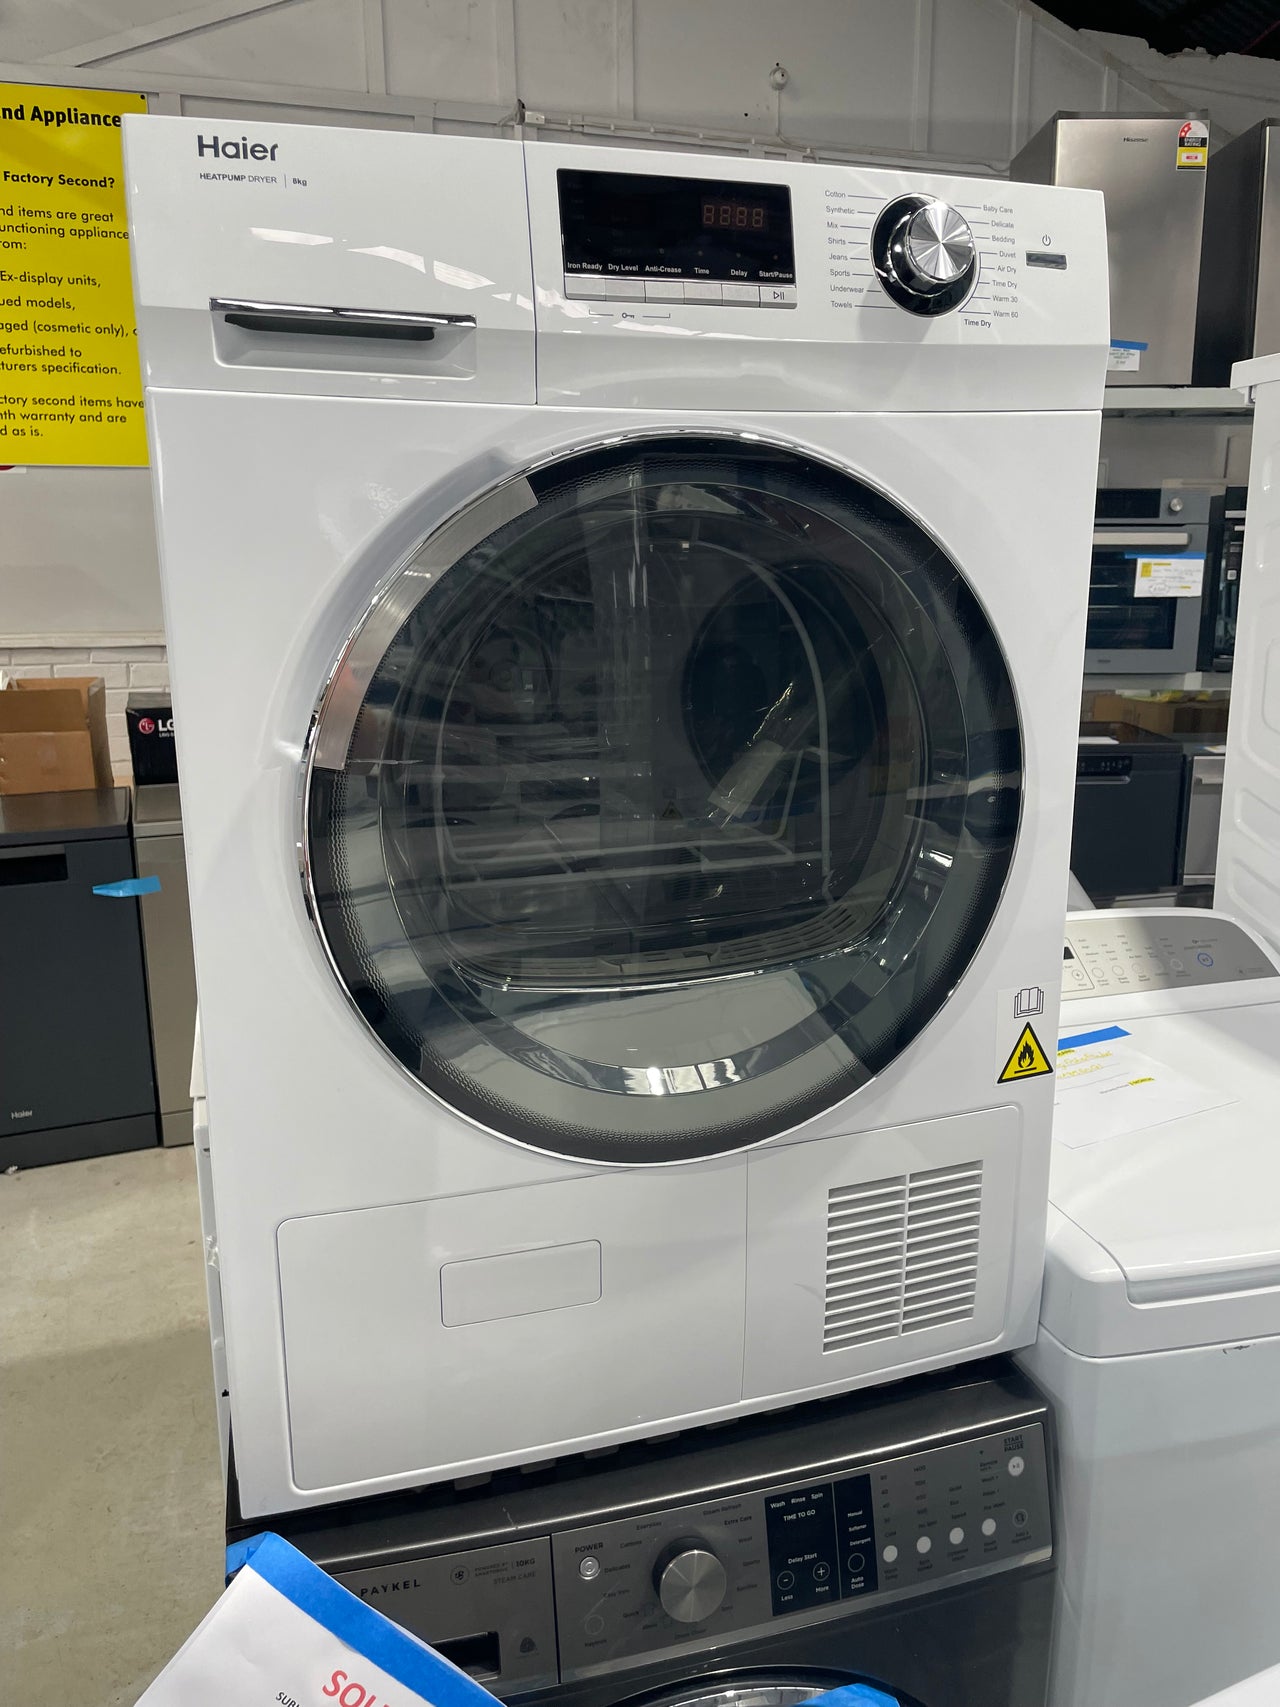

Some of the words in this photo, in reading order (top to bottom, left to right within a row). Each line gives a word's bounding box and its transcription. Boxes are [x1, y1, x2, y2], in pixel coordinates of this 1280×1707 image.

[197, 134, 279, 161] Haier
[3, 171, 53, 187] Factory
[58, 174, 115, 188] Second?
[199, 172, 246, 182] HEATPUMP
[248, 175, 277, 184] DRYER
[292, 177, 307, 187] 8kg
[824, 190, 846, 199] Cotton
[826, 205, 855, 216] Synthetic
[983, 204, 997, 214] Baby
[998, 206, 1013, 214] Care
[18, 206, 52, 218] items
[56, 211, 77, 220] are
[81, 212, 114, 223] great
[826, 221, 838, 230] Mix
[991, 220, 1014, 229] Delicate
[827, 237, 846, 246] Shirts
[991, 235, 1016, 245] Bedding
[829, 253, 848, 261] Jeans
[999, 250, 1016, 259] Duvet
[567, 262, 581, 270] Iron
[582, 263, 603, 272] Ready
[608, 263, 619, 272] Dry
[644, 265, 682, 274] Anti-Crease
[694, 267, 710, 275] Time
[1005, 266, 1017, 274] Dry
[730, 269, 748, 277] Delay
[758, 270, 793, 279] Start/Pause
[829, 269, 850, 278] Sports
[1, 271, 63, 287] Ex-display
[68, 275, 101, 288] units,
[830, 286, 864, 294] Underwear
[992, 280, 1005, 288] Time
[1006, 281, 1017, 290] Dry
[26, 297, 75, 310] models,
[831, 301, 853, 309] Towels
[1010, 311, 1018, 319] 60
[0, 320, 28, 333] aged
[33, 320, 91, 334] (cosmetic
[95, 323, 129, 338] only),
[964, 319, 978, 327] Time
[980, 320, 991, 329] Dry
[0, 343, 66, 357] efurbished
[70, 347, 82, 358] to
[0, 361, 37, 372] turers
[41, 362, 121, 376] specification.
[32, 395, 75, 407] second
[79, 395, 113, 408] items
[116, 396, 144, 409] have
[20, 410, 75, 424] warranty
[80, 410, 103, 423] and
[107, 414, 127, 424] are
[12, 428, 26, 437] as
[30, 426, 44, 437] is.
[770, 1500, 786, 1509] Wash
[791, 1496, 806, 1505] Rinse
[811, 1491, 824, 1500] Spin
[783, 1513, 796, 1521] TIME
[798, 1510, 806, 1518] TO
[724, 1519, 738, 1527] Extra
[575, 1542, 603, 1553] POWER
[515, 1558, 536, 1568] 10KG
[788, 1556, 803, 1565] Delay
[804, 1552, 818, 1561] Start
[360, 1578, 421, 1597] PAYKEL
[815, 1585, 829, 1593] More
[850, 1582, 864, 1590] Dose
[322, 1669, 389, 1707] SO
